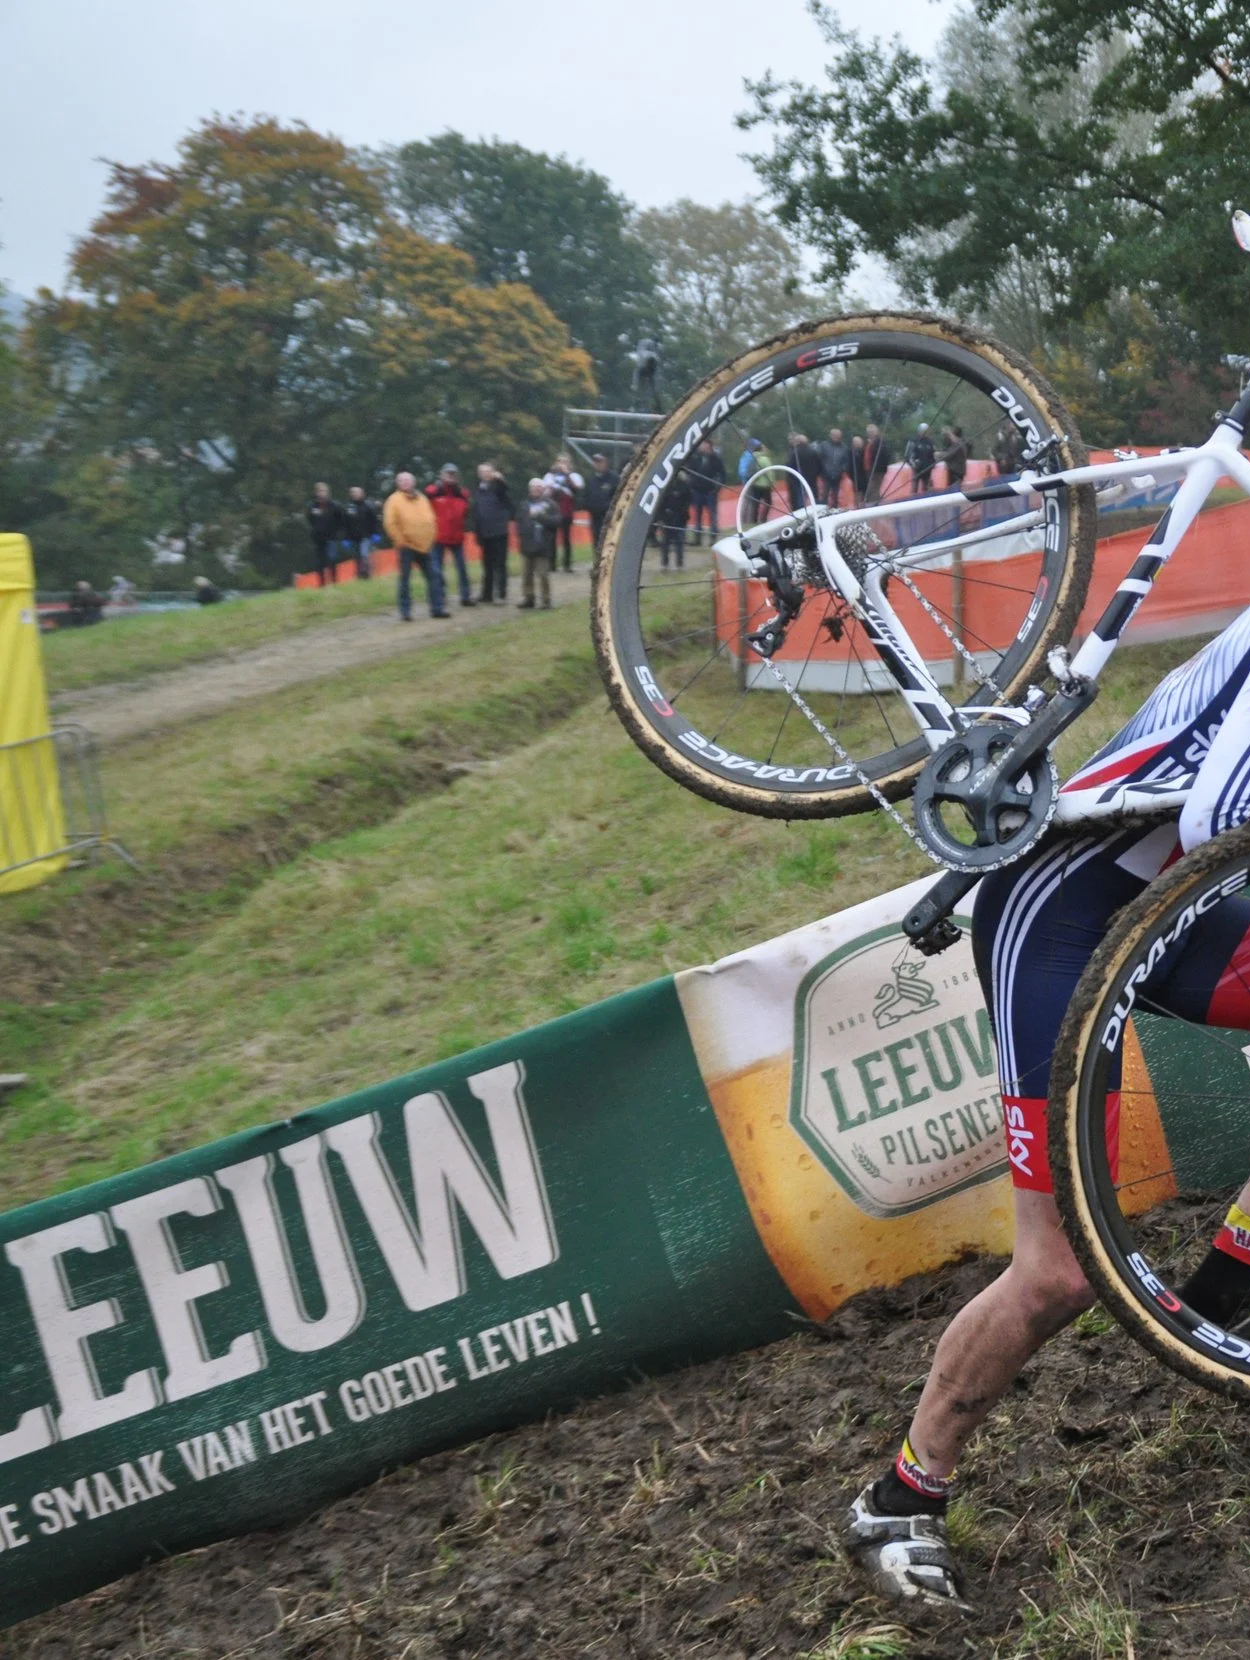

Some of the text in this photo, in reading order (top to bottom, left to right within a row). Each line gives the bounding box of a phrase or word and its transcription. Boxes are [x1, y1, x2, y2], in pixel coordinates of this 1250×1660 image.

[796, 342, 860, 368] C35
[639, 365, 775, 515] DURA-ACE
[991, 386, 1060, 552] DURCE
[1016, 575, 1049, 645] C35
[634, 665, 674, 717] C35
[679, 730, 857, 783] DURA-ACE
[1101, 867, 1249, 1054] DURA-ACE
[828, 1012, 867, 1037] ANNO
[1005, 1104, 1034, 1177] sky
[1126, 1251, 1183, 1314] C35
[31, 1450, 177, 1535] SMAAK
[176, 1429, 259, 1484] VAN
[258, 1390, 336, 1456] HET
[339, 1345, 459, 1423] GOEDE
[457, 1302, 583, 1383] LEVEN
[581, 1293, 603, 1336] !
